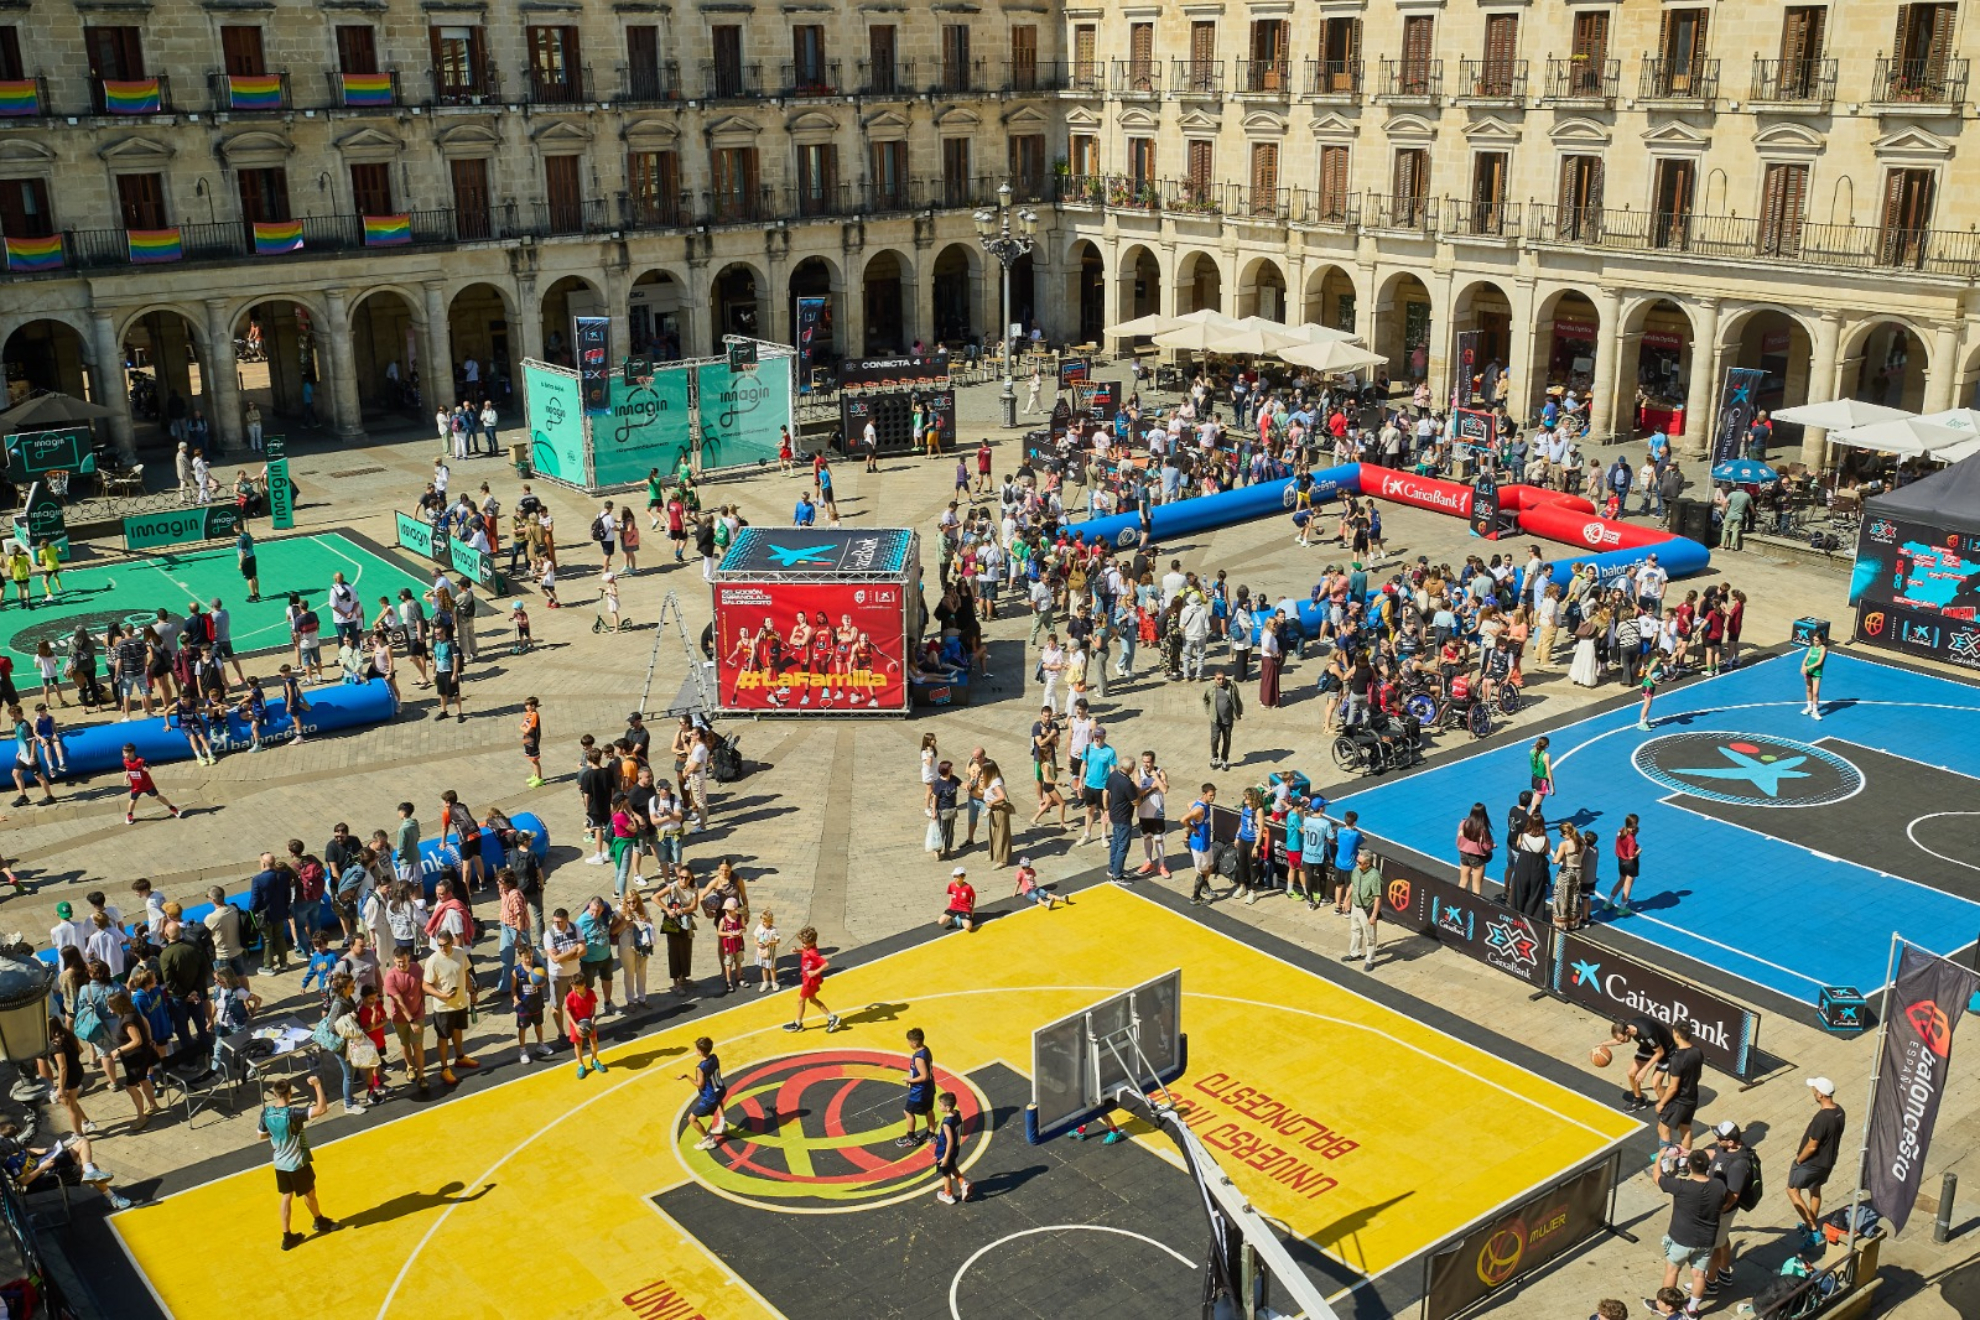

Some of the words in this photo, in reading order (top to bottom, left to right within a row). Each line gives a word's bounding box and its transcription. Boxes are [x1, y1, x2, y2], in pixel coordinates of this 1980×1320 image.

[861, 359, 910, 369] CONECTA
[720, 387, 770, 403] imagin
[615, 399, 668, 417] imagin
[34, 438, 65, 448] imagin
[270, 464, 287, 521] imagin
[1404, 483, 1458, 508] CaixaBank
[30, 509, 63, 519] imagin
[131, 518, 199, 538] imagin
[401, 523, 428, 546] imagin
[738, 669, 887, 690] #LaFamilia
[1306, 831, 1318, 847] 10
[1487, 952, 1532, 980] CaixaBank
[1899, 1040, 1919, 1092] ESPAÑA
[1193, 1073, 1361, 1160] BALONCESTO
[1892, 1045, 1936, 1182] baloncesto
[1202, 1123, 1339, 1200] UNIVERSO
[1529, 1213, 1566, 1244] MUJER
